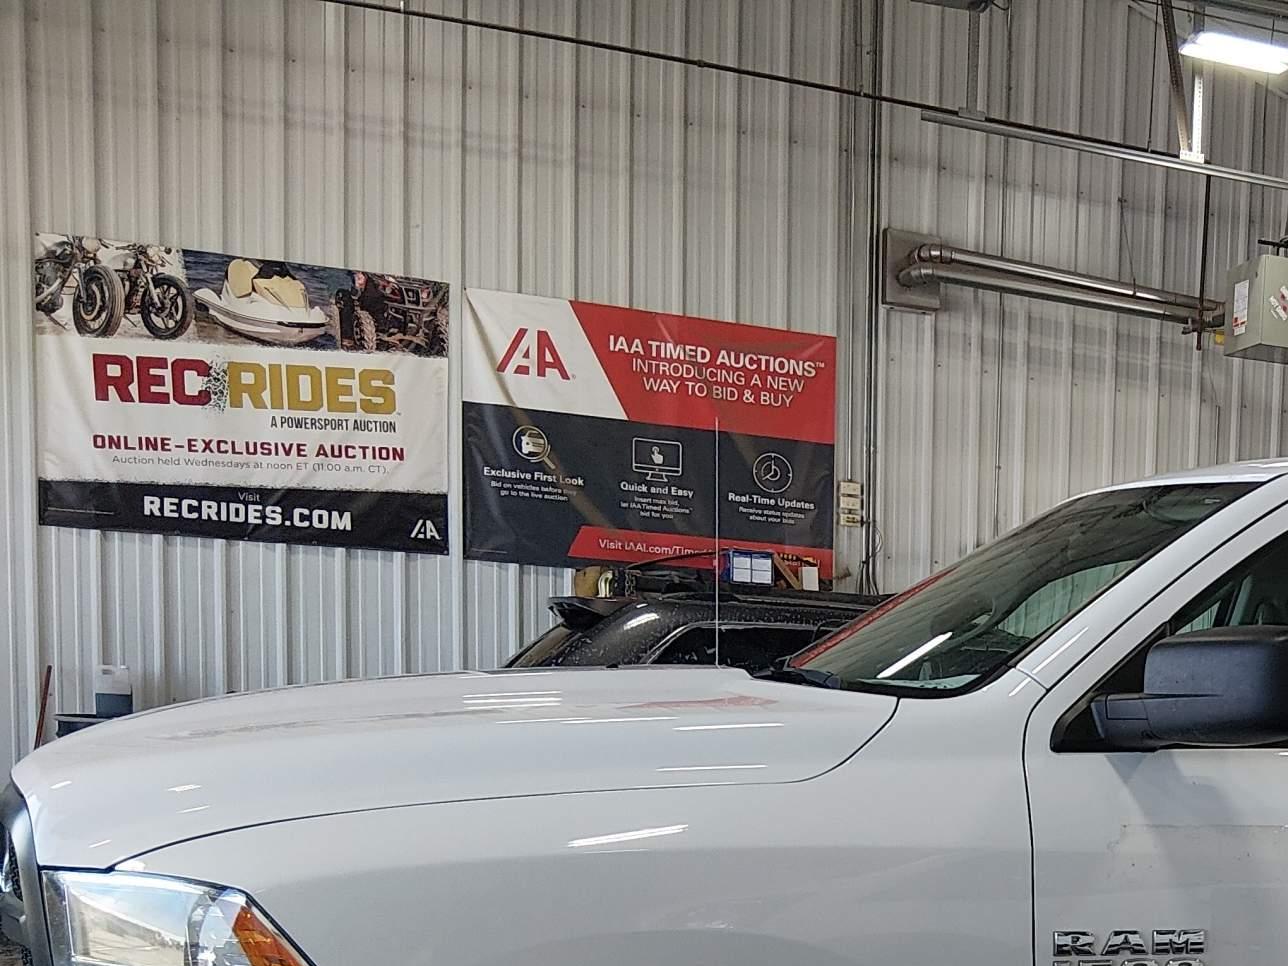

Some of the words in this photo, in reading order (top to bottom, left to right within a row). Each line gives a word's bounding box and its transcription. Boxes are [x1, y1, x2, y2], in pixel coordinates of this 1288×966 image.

[609, 335, 644, 355] IAA
[648, 340, 710, 363] TIMED
[92, 353, 212, 406] REC
[227, 361, 397, 415] RIDES
[633, 357, 745, 385] INTRODUCING
[750, 375, 762, 388] A
[767, 375, 804, 392] NEW
[643, 377, 680, 393] WAY
[684, 381, 707, 396] TO
[712, 386, 737, 400] BID
[743, 391, 755, 404] &
[760, 391, 793, 407] BUY
[270, 415, 278, 428] A
[280, 416, 349, 431] POWERSPORT
[353, 419, 396, 433] AUCTION
[92, 434, 307, 458] ONLINE-EXCLUSIVE
[315, 443, 405, 461] AUCTION
[112, 455, 154, 465] Auction
[157, 457, 181, 466] held
[183, 458, 250, 470] Wednesdays
[253, 461, 262, 469] at
[266, 461, 293, 471] noon
[296, 462, 309, 471] ET
[483, 467, 531, 479] Exclusive
[534, 472, 557, 483] First
[560, 475, 584, 486] Look
[238, 491, 260, 502] Visit
[620, 481, 648, 493] Quick
[650, 486, 669, 495] and
[671, 486, 694, 499] Easy
[728, 492, 776, 506] Real-Time
[778, 497, 815, 510] Updates
[143, 495, 352, 531] RECRIDES.COM
[599, 539, 622, 549] Visit
[1053, 929, 1206, 957] RAM
